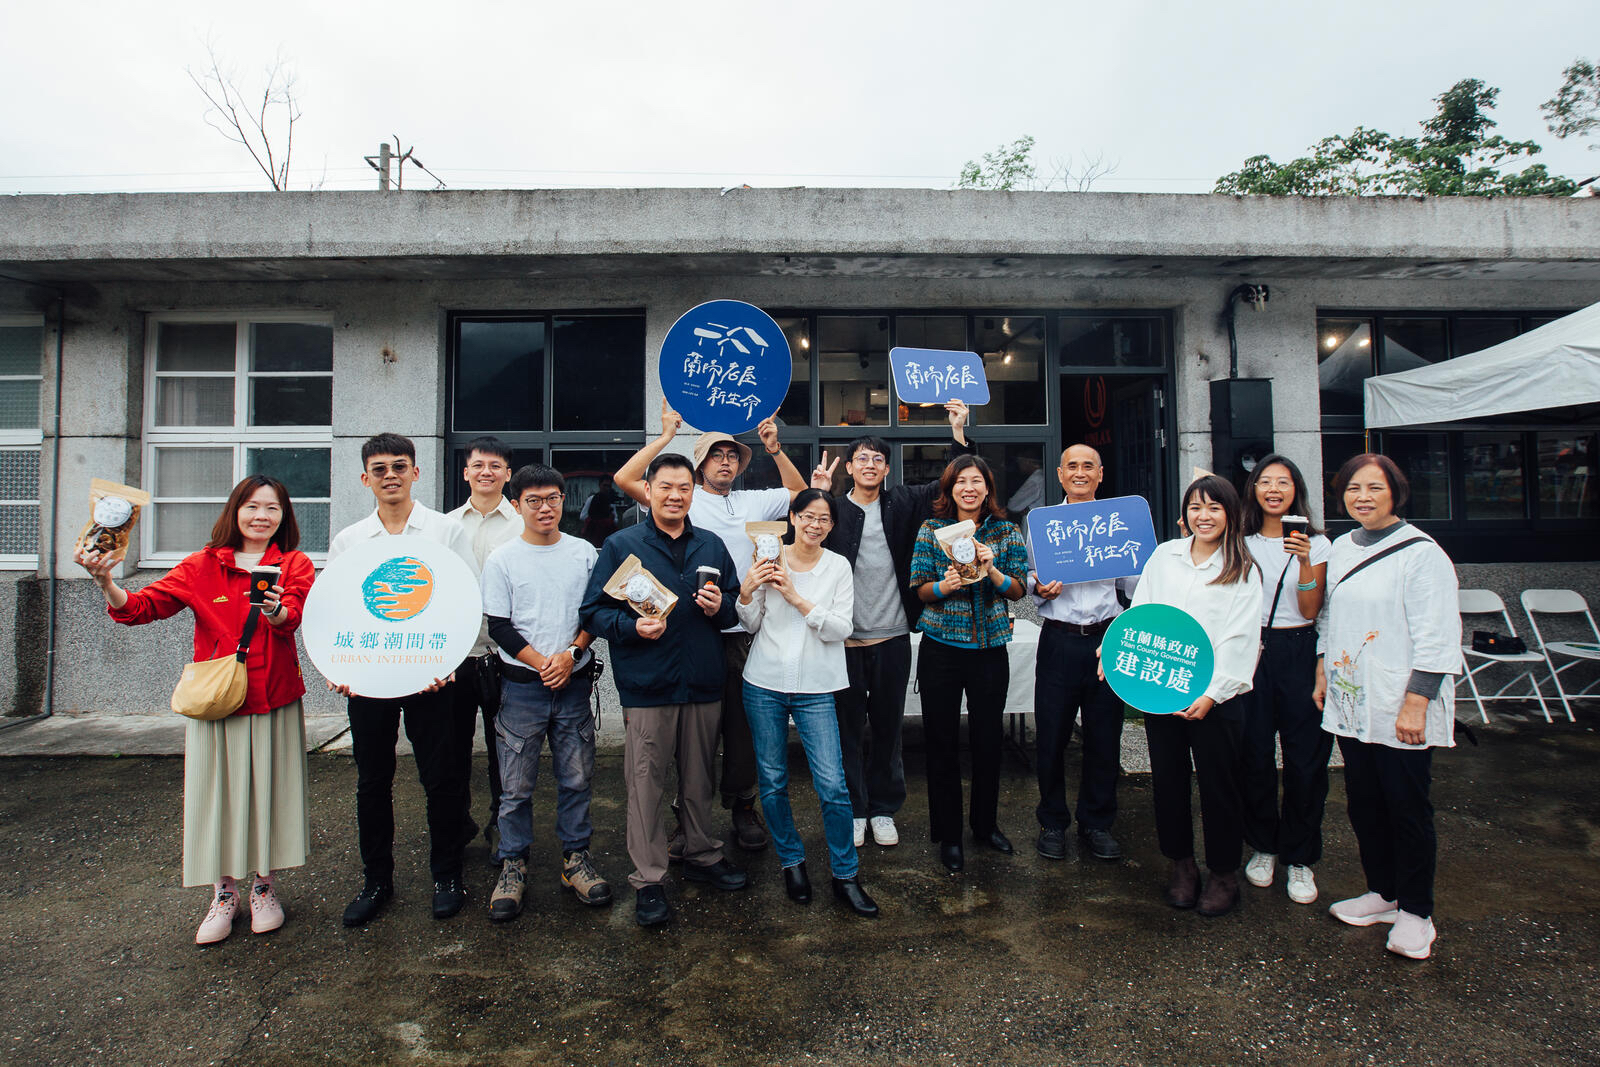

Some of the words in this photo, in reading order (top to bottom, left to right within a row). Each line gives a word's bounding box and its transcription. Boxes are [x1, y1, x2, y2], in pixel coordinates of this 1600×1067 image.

[707, 387, 761, 420] 新生命
[1085, 540, 1141, 568] 新生命
[333, 631, 447, 650] 城鄉潮間帶
[1123, 627, 1199, 659] 宜蘭縣政府
[1137, 645, 1159, 656] County
[331, 654, 371, 664] URBAN
[377, 655, 444, 665] INTERTIDAL
[1113, 650, 1193, 694] 建設處
